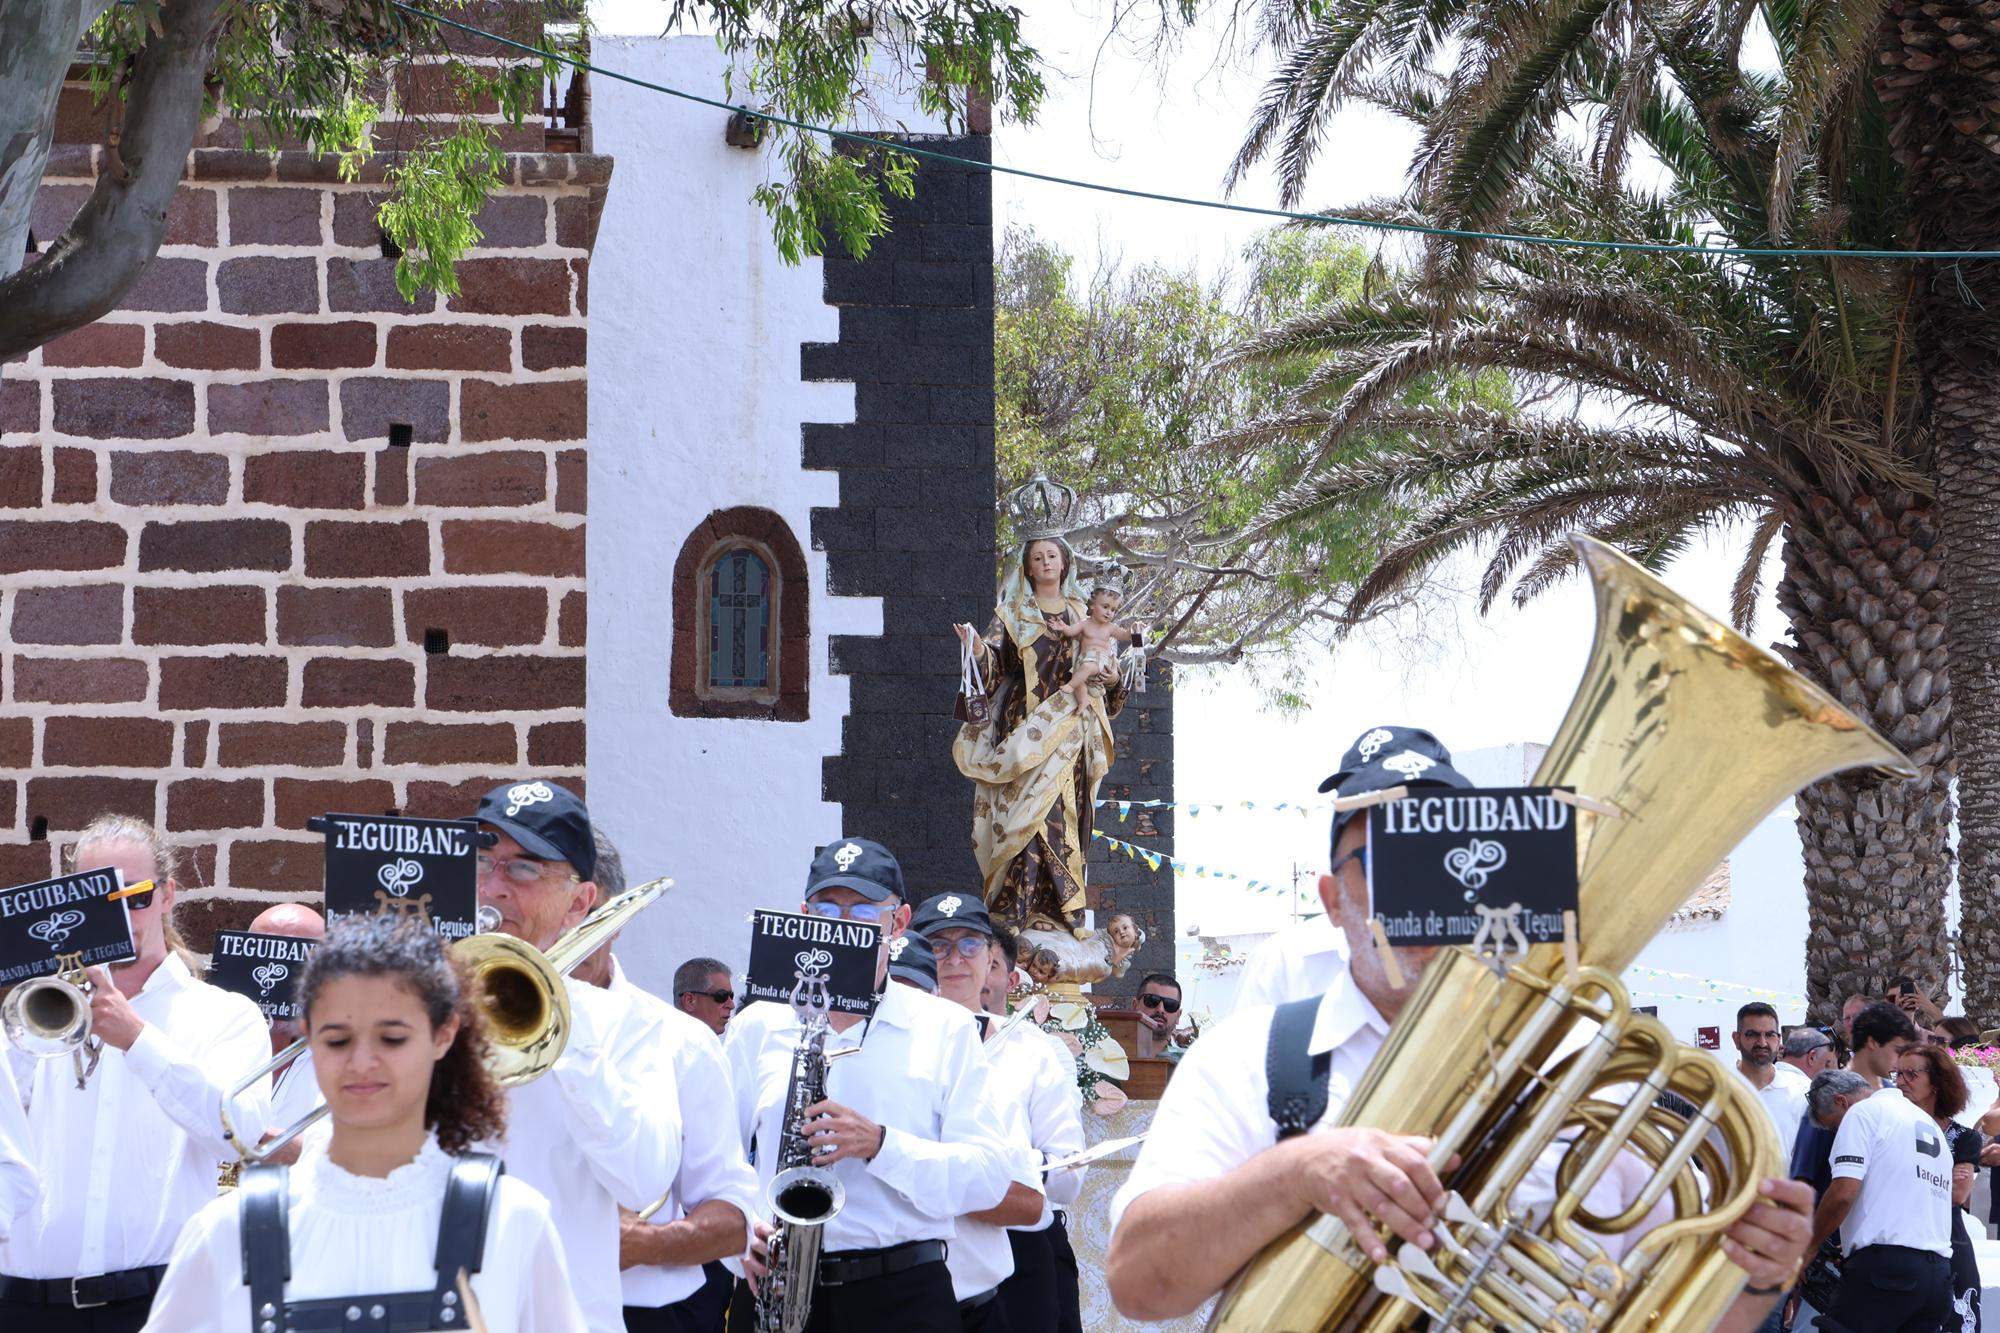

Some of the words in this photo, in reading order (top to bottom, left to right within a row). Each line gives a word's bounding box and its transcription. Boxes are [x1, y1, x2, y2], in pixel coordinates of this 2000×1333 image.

[1379, 795, 1569, 834] TEGUIBAND
[333, 820, 470, 856] TEGUIBAND
[0, 874, 111, 918] EGUIBAND
[432, 915, 474, 943] Teguise
[760, 914, 875, 949] TEGUIBAND
[1424, 909, 1444, 937] de
[1521, 907, 1564, 941] Tegui
[0, 963, 32, 981] BANDA
[32, 959, 46, 973] DE
[94, 940, 132, 960] TEGUISE
[220, 935, 320, 962] TEGUIBAN
[751, 983, 778, 999] Banda
[779, 986, 791, 1000] de
[836, 994, 869, 1012] Teguise
